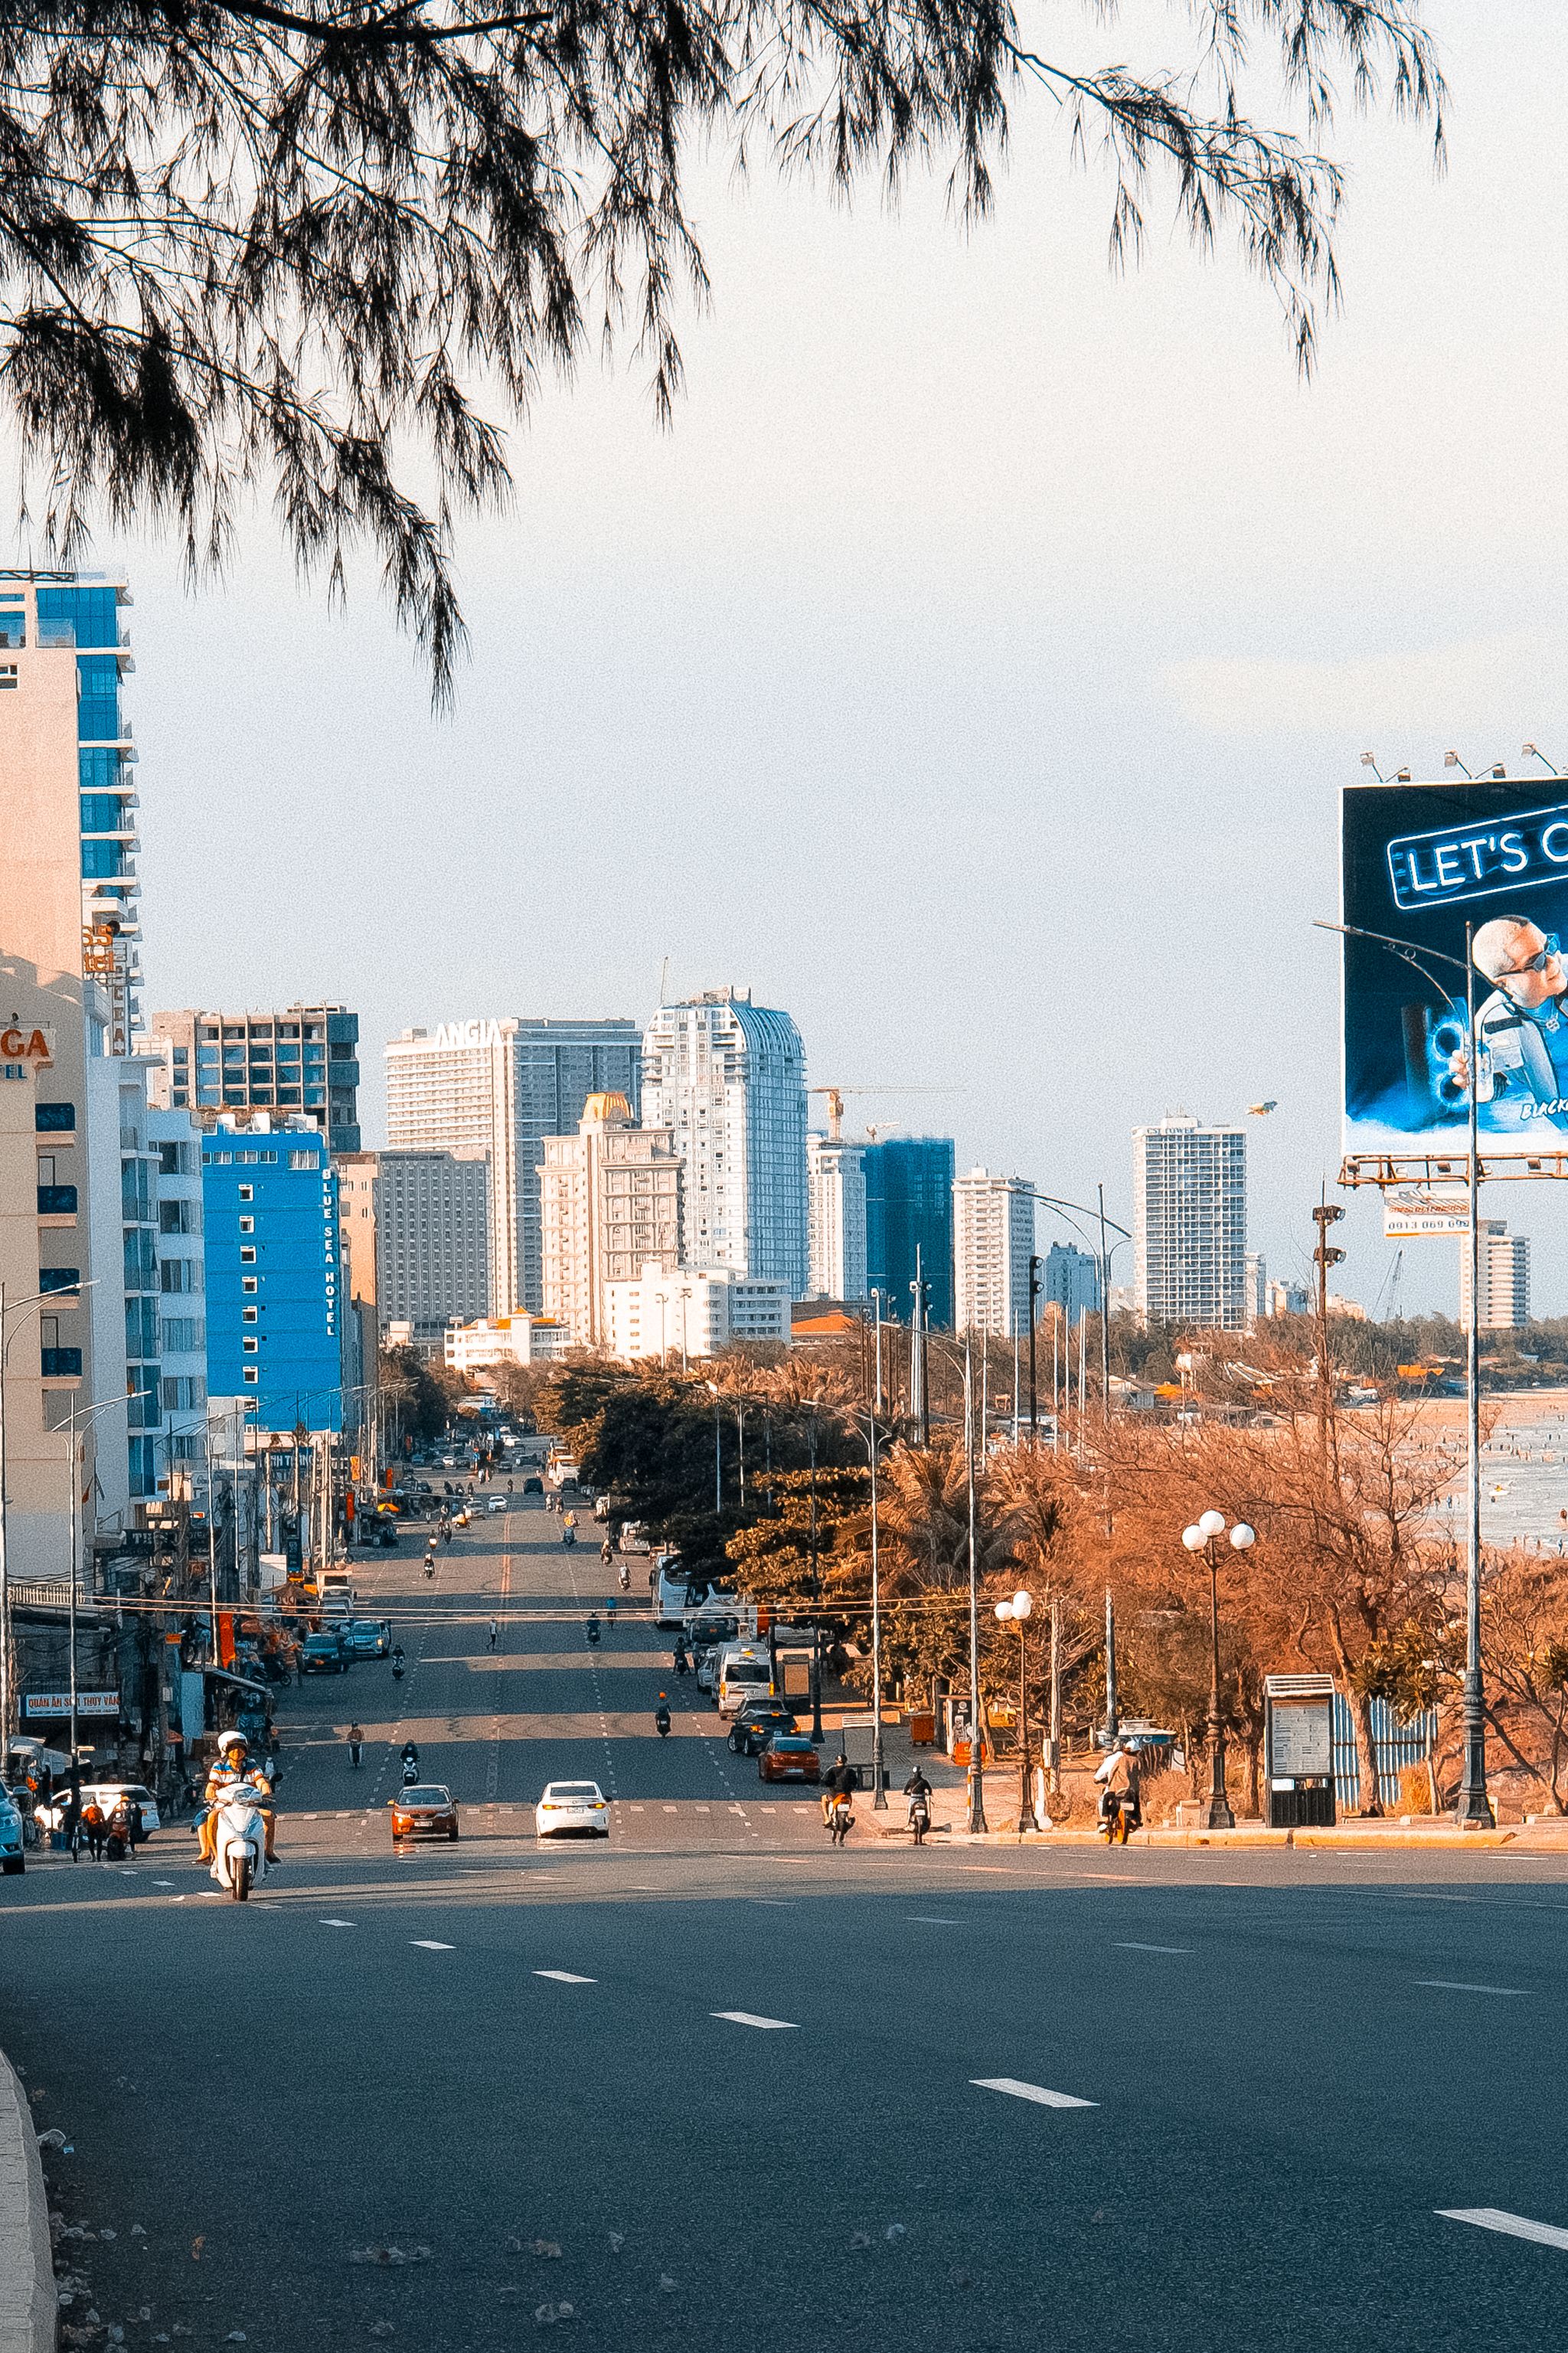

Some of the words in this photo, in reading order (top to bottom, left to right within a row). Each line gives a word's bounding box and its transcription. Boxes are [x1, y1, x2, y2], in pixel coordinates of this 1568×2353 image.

[1408, 832, 1528, 891] LET'S
[0, 1064, 27, 1079] EL
[1521, 1098, 1568, 1120] BLACK
[322, 1168, 332, 1219] BLUE
[324, 1227, 334, 1263] SEA
[325, 1272, 335, 1336] HOTEL
